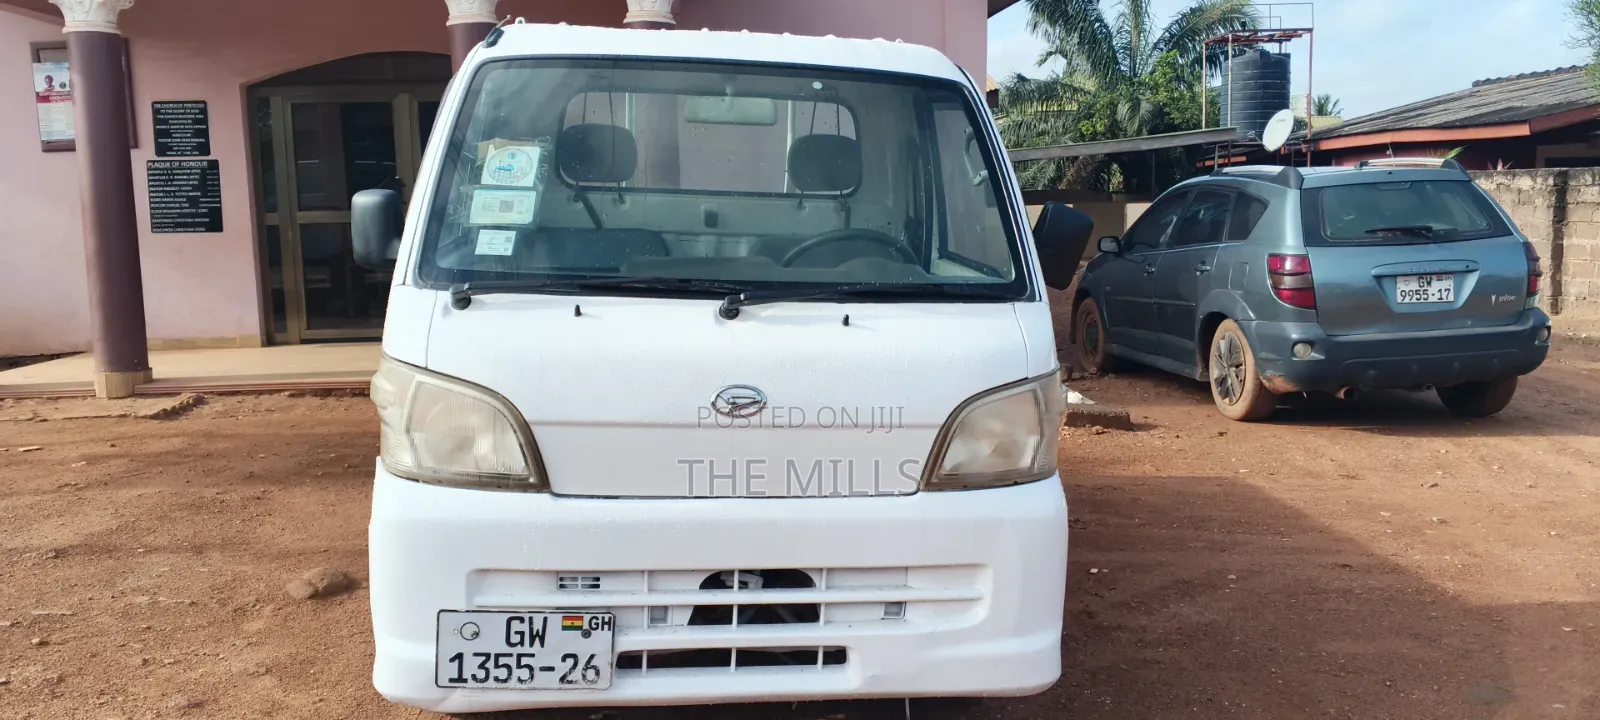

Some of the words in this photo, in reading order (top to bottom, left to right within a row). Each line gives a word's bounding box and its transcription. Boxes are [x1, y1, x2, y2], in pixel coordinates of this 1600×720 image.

[1418, 276, 1432, 288] GW
[1400, 288, 1451, 301] 9955-17
[505, 616, 548, 648] GW
[588, 616, 612, 631] GH
[448, 652, 600, 685] 1355-26
